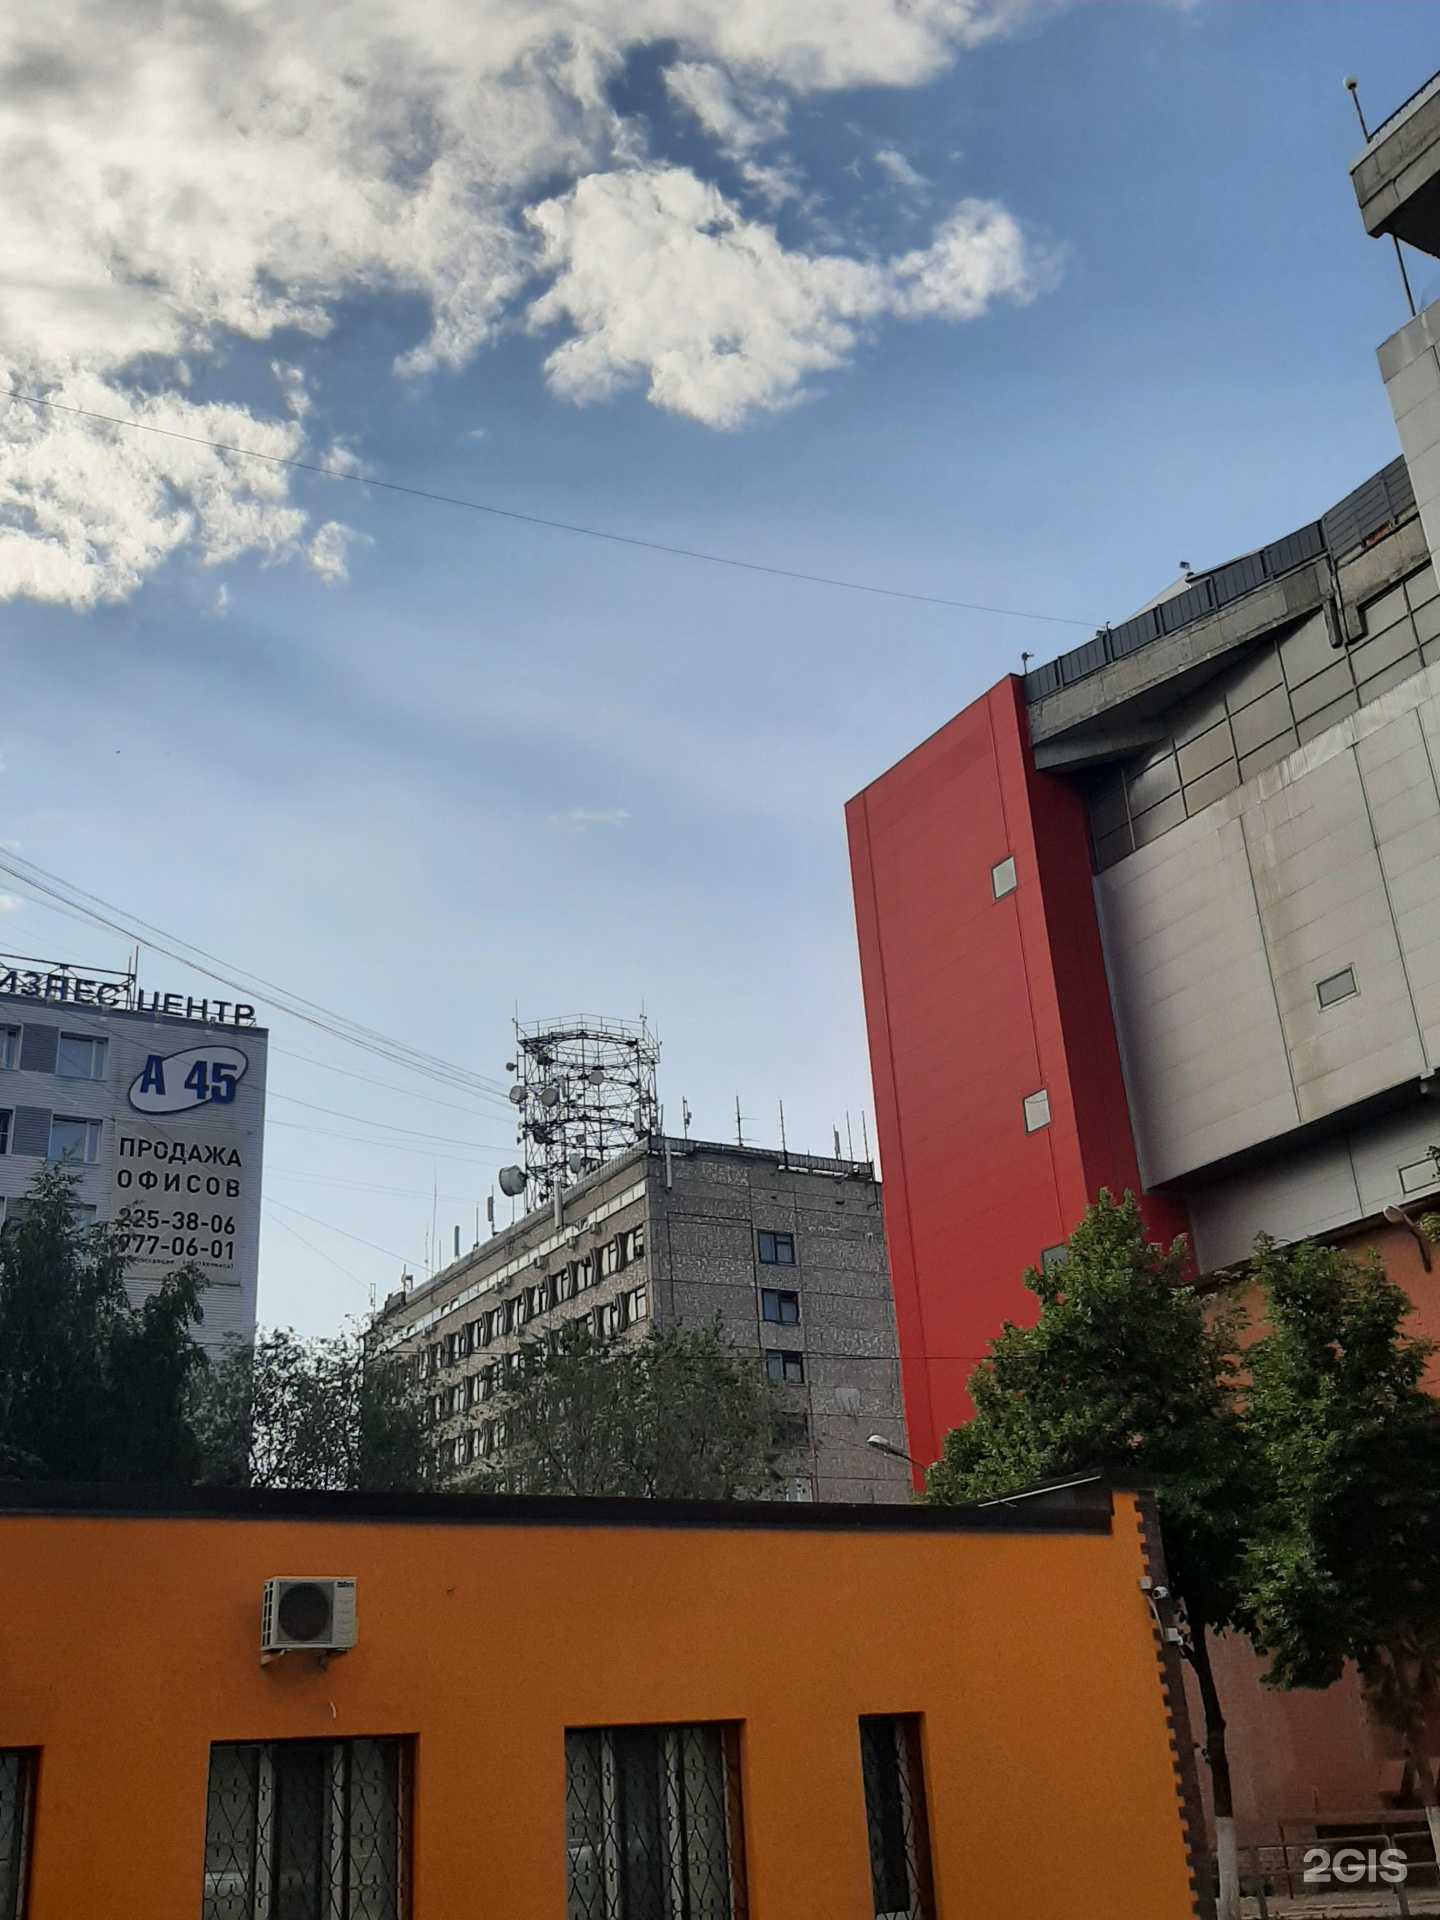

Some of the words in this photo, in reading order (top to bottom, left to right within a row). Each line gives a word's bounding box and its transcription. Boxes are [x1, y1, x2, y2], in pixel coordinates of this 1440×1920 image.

[137, 986, 256, 1025] ЦЕНТР
[184, 1060, 238, 1104] 45
[119, 1137, 242, 1167] ПРОДАЖА
[117, 1169, 240, 1198] ОФИСОВ
[118, 1207, 236, 1235] 225-38-06
